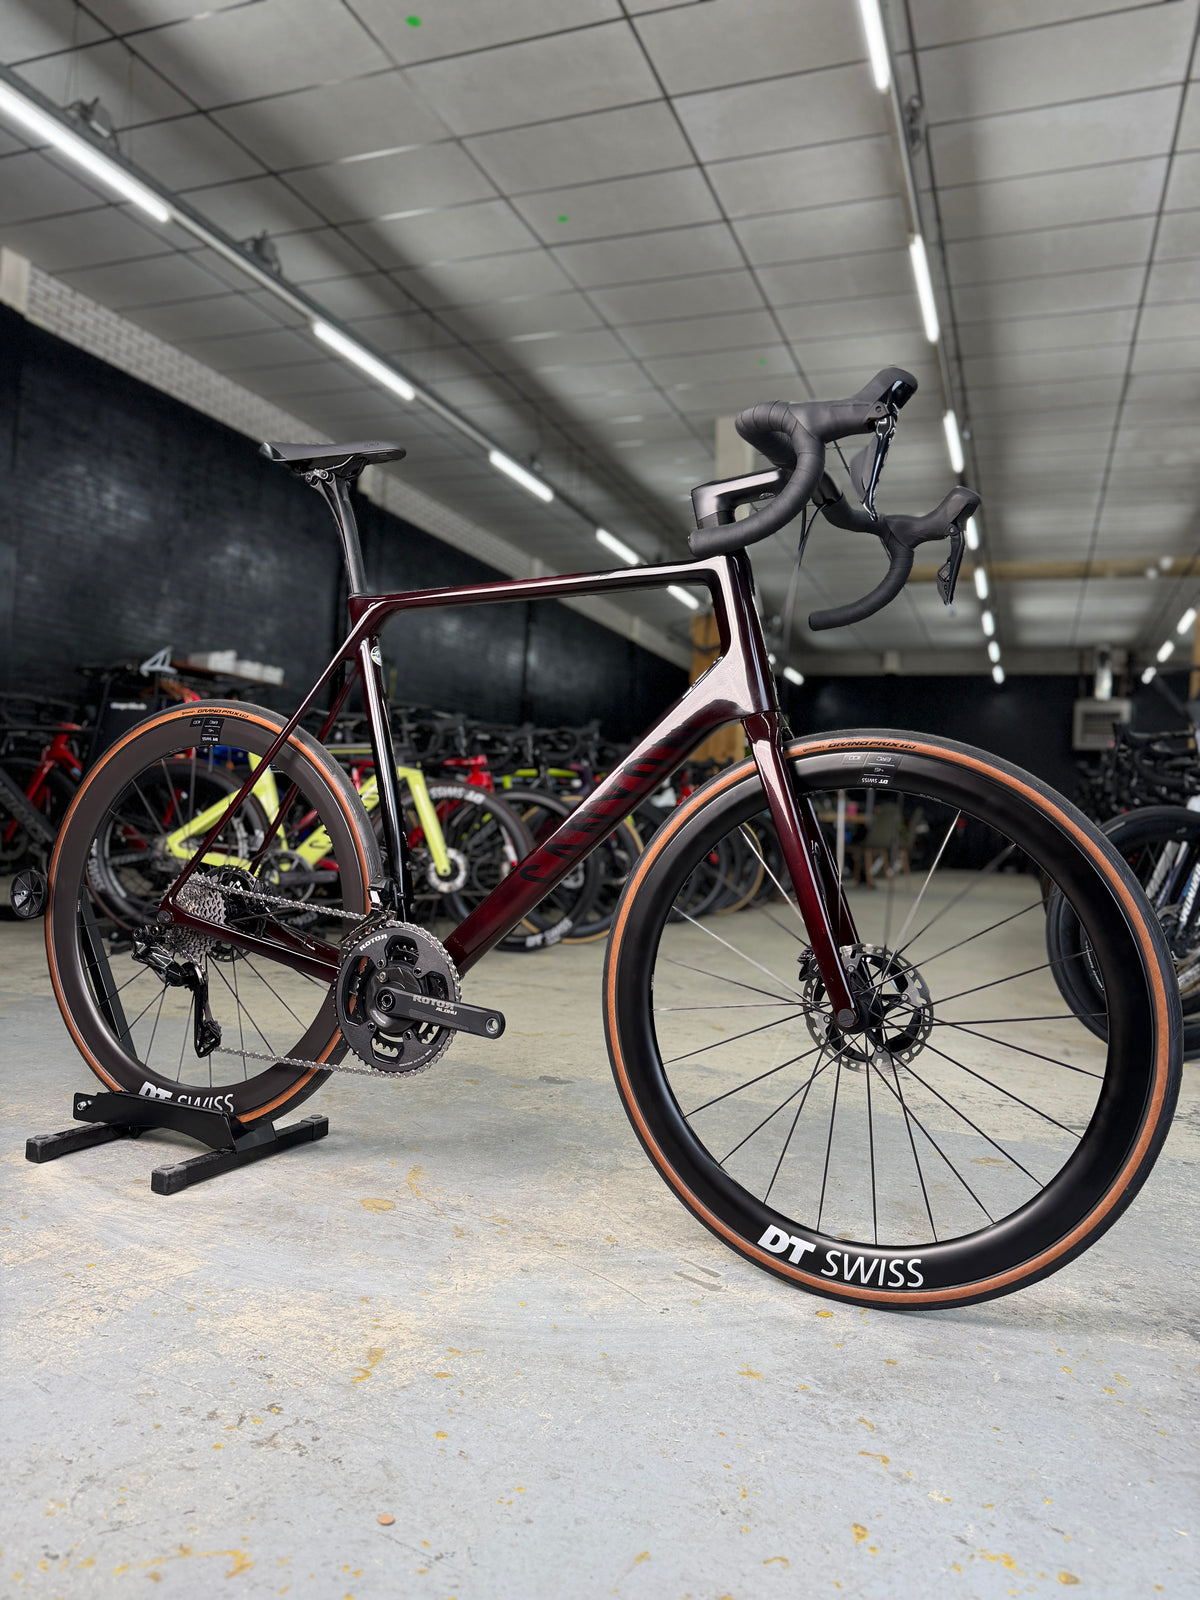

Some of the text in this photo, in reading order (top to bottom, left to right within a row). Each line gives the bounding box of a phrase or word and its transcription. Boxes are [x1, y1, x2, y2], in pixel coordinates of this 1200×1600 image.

[828, 740, 868, 748] GRAND
[359, 933, 388, 952] ROTOR
[412, 995, 454, 1010] ROTOR
[757, 1224, 924, 1287] DT SWISS
